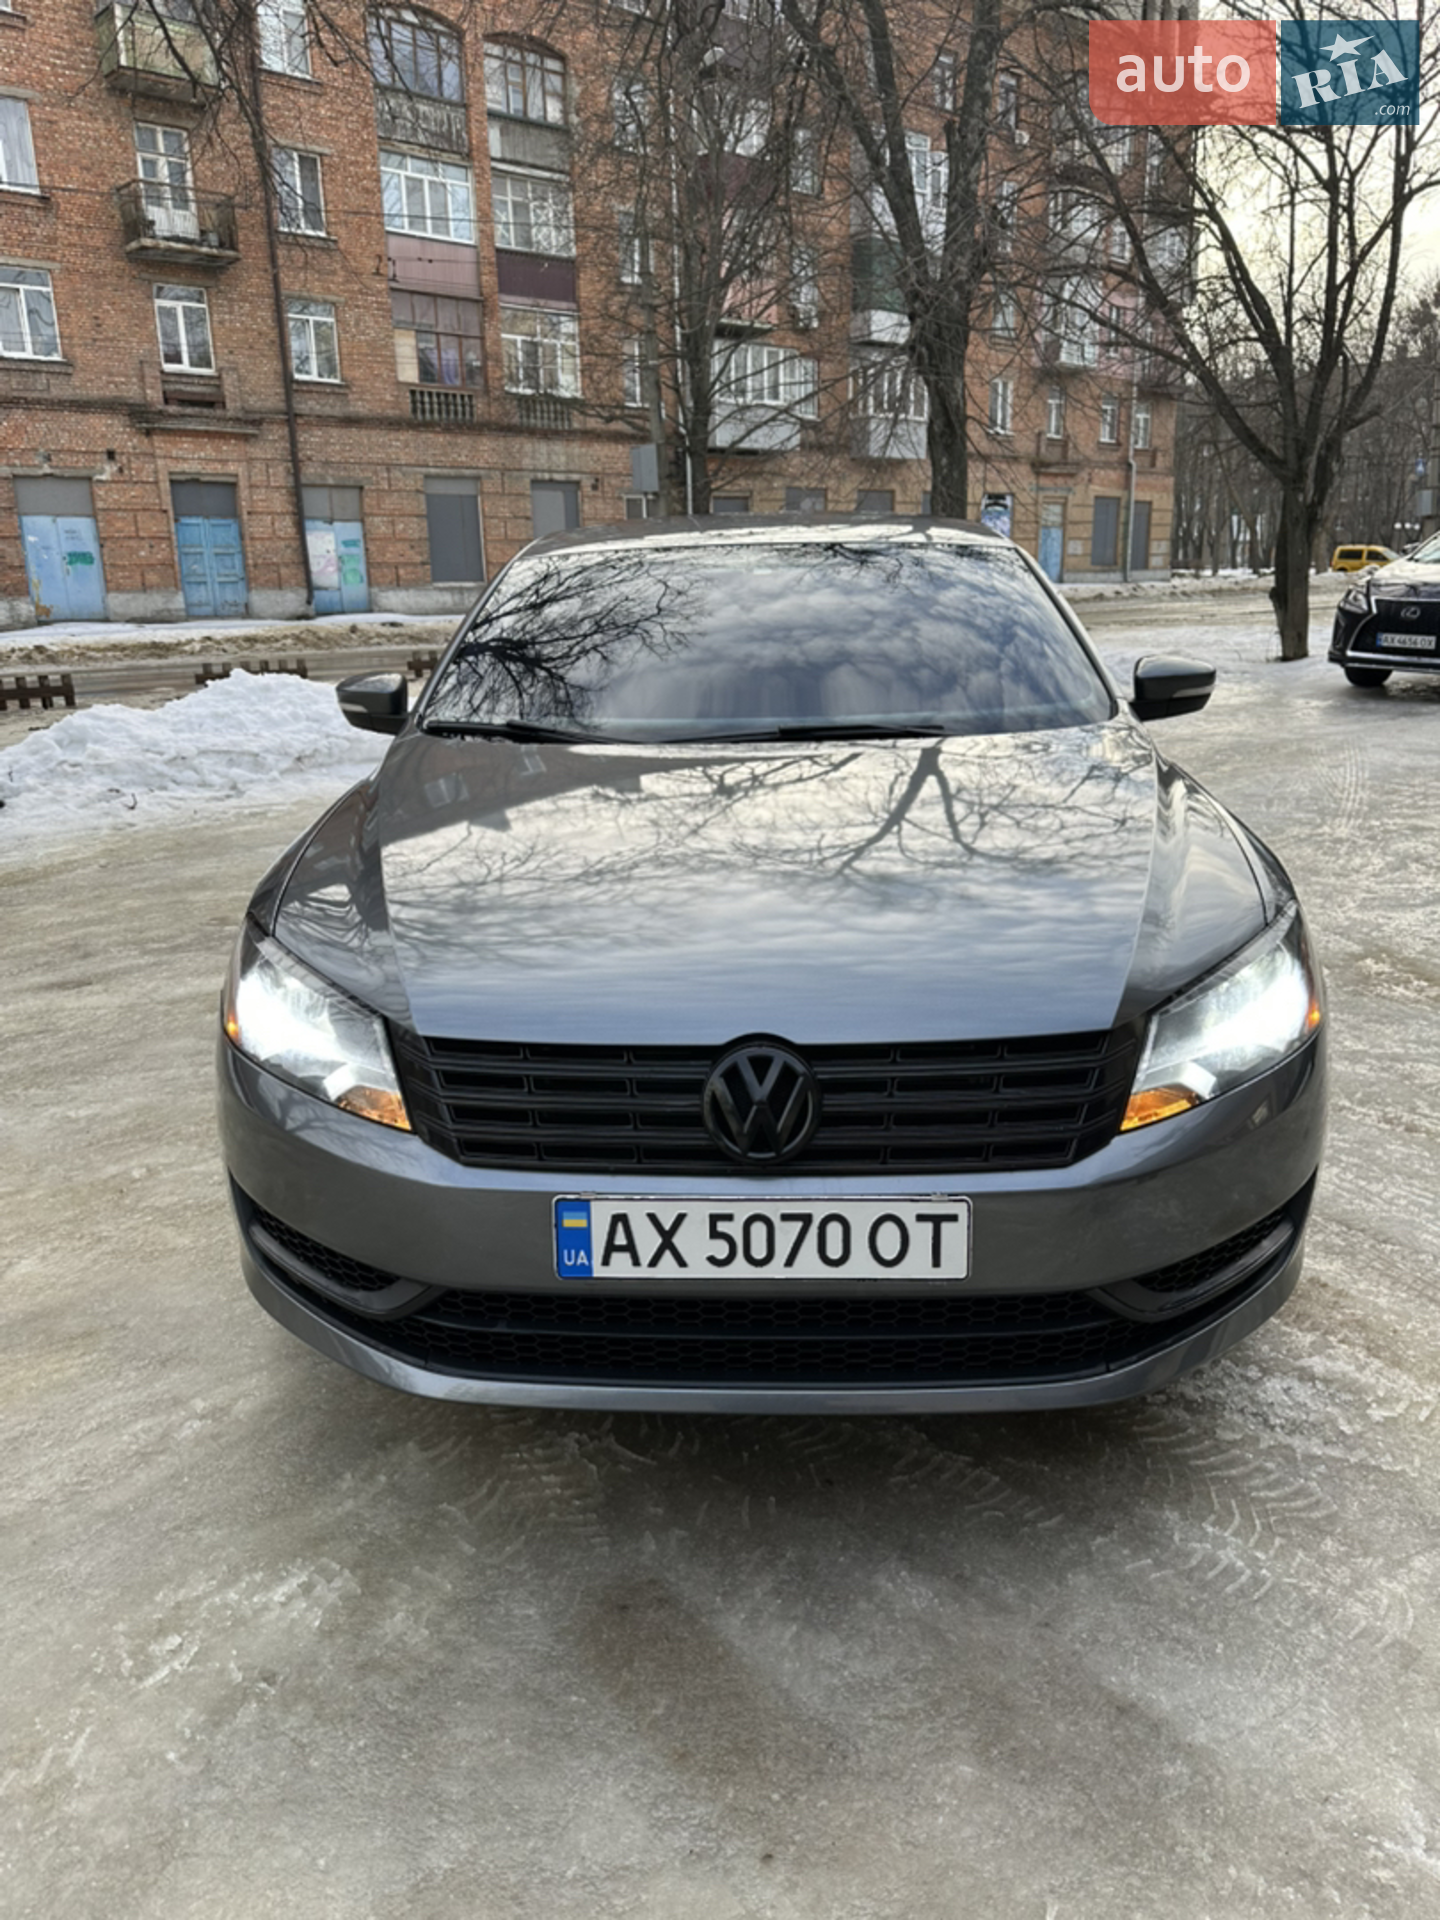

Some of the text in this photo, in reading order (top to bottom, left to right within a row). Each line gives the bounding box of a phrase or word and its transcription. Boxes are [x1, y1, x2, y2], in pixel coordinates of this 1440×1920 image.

[563, 1249, 589, 1267] UA
[601, 1212, 959, 1268] AX 5070 OT
